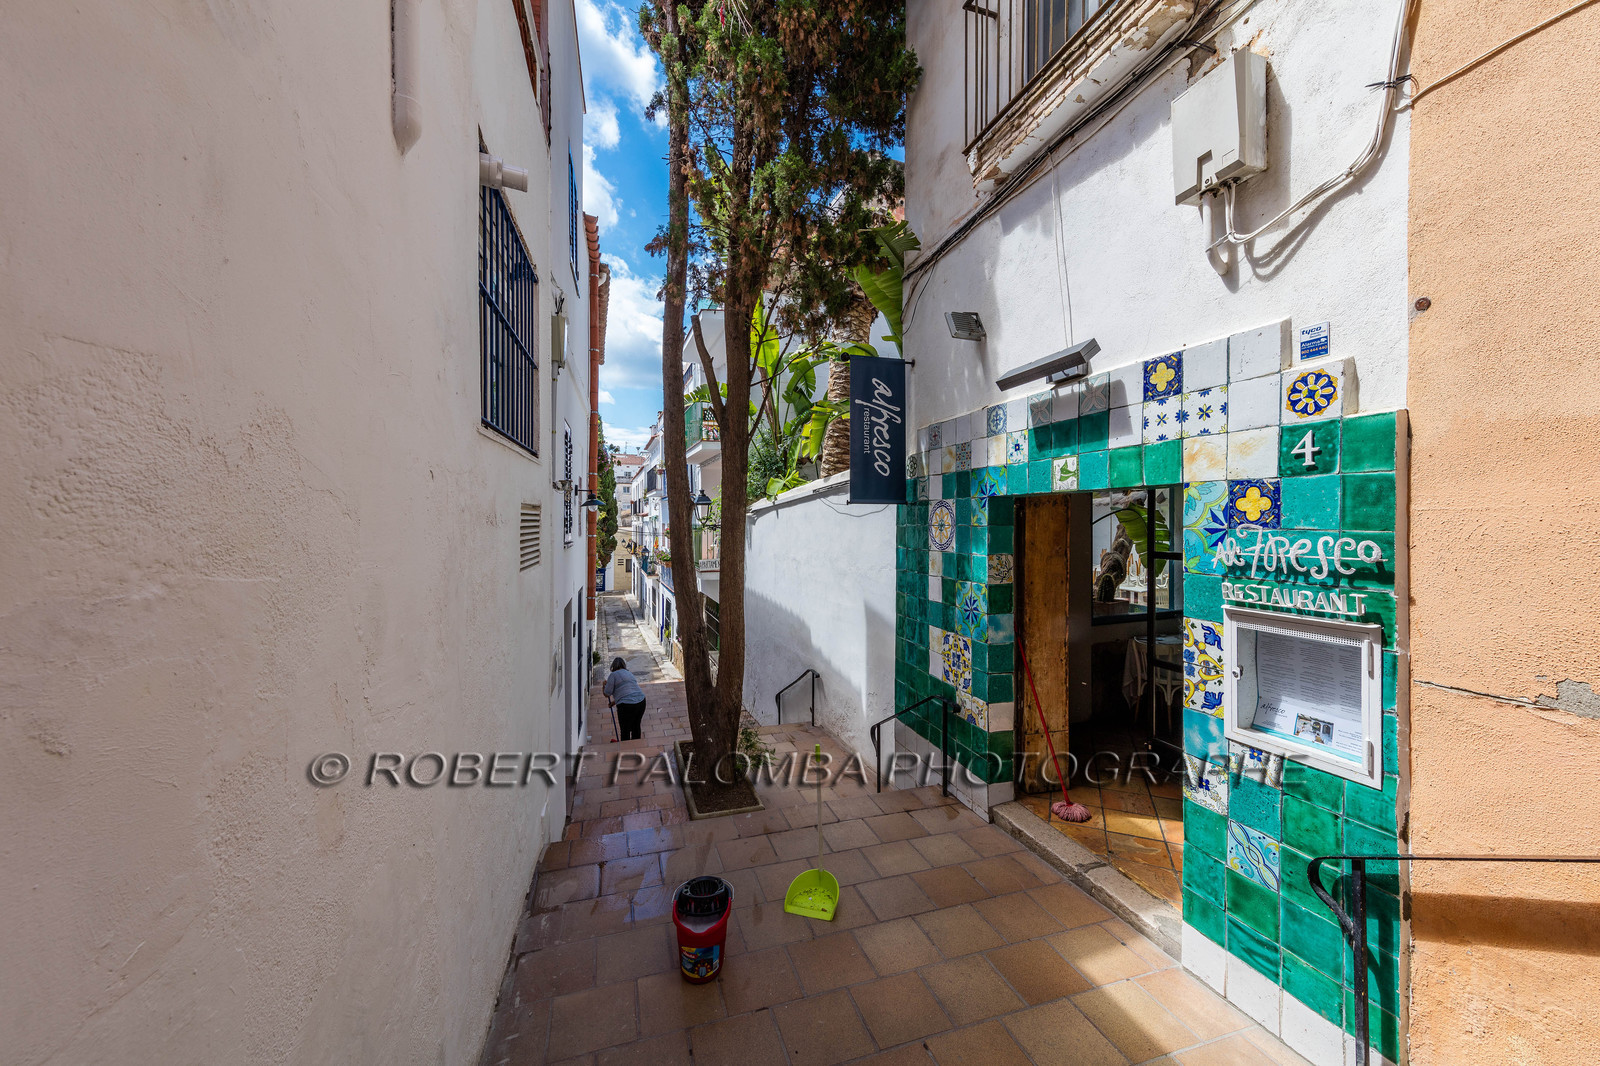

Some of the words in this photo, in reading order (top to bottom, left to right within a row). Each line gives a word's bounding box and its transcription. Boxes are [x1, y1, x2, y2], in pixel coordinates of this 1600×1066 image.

[1302, 326, 1321, 335] tyco
[855, 377, 901, 477] alfresco
[863, 407, 871, 454] restaurant
[1290, 429, 1320, 466] 4
[1221, 582, 1368, 616] RESTAURANT
